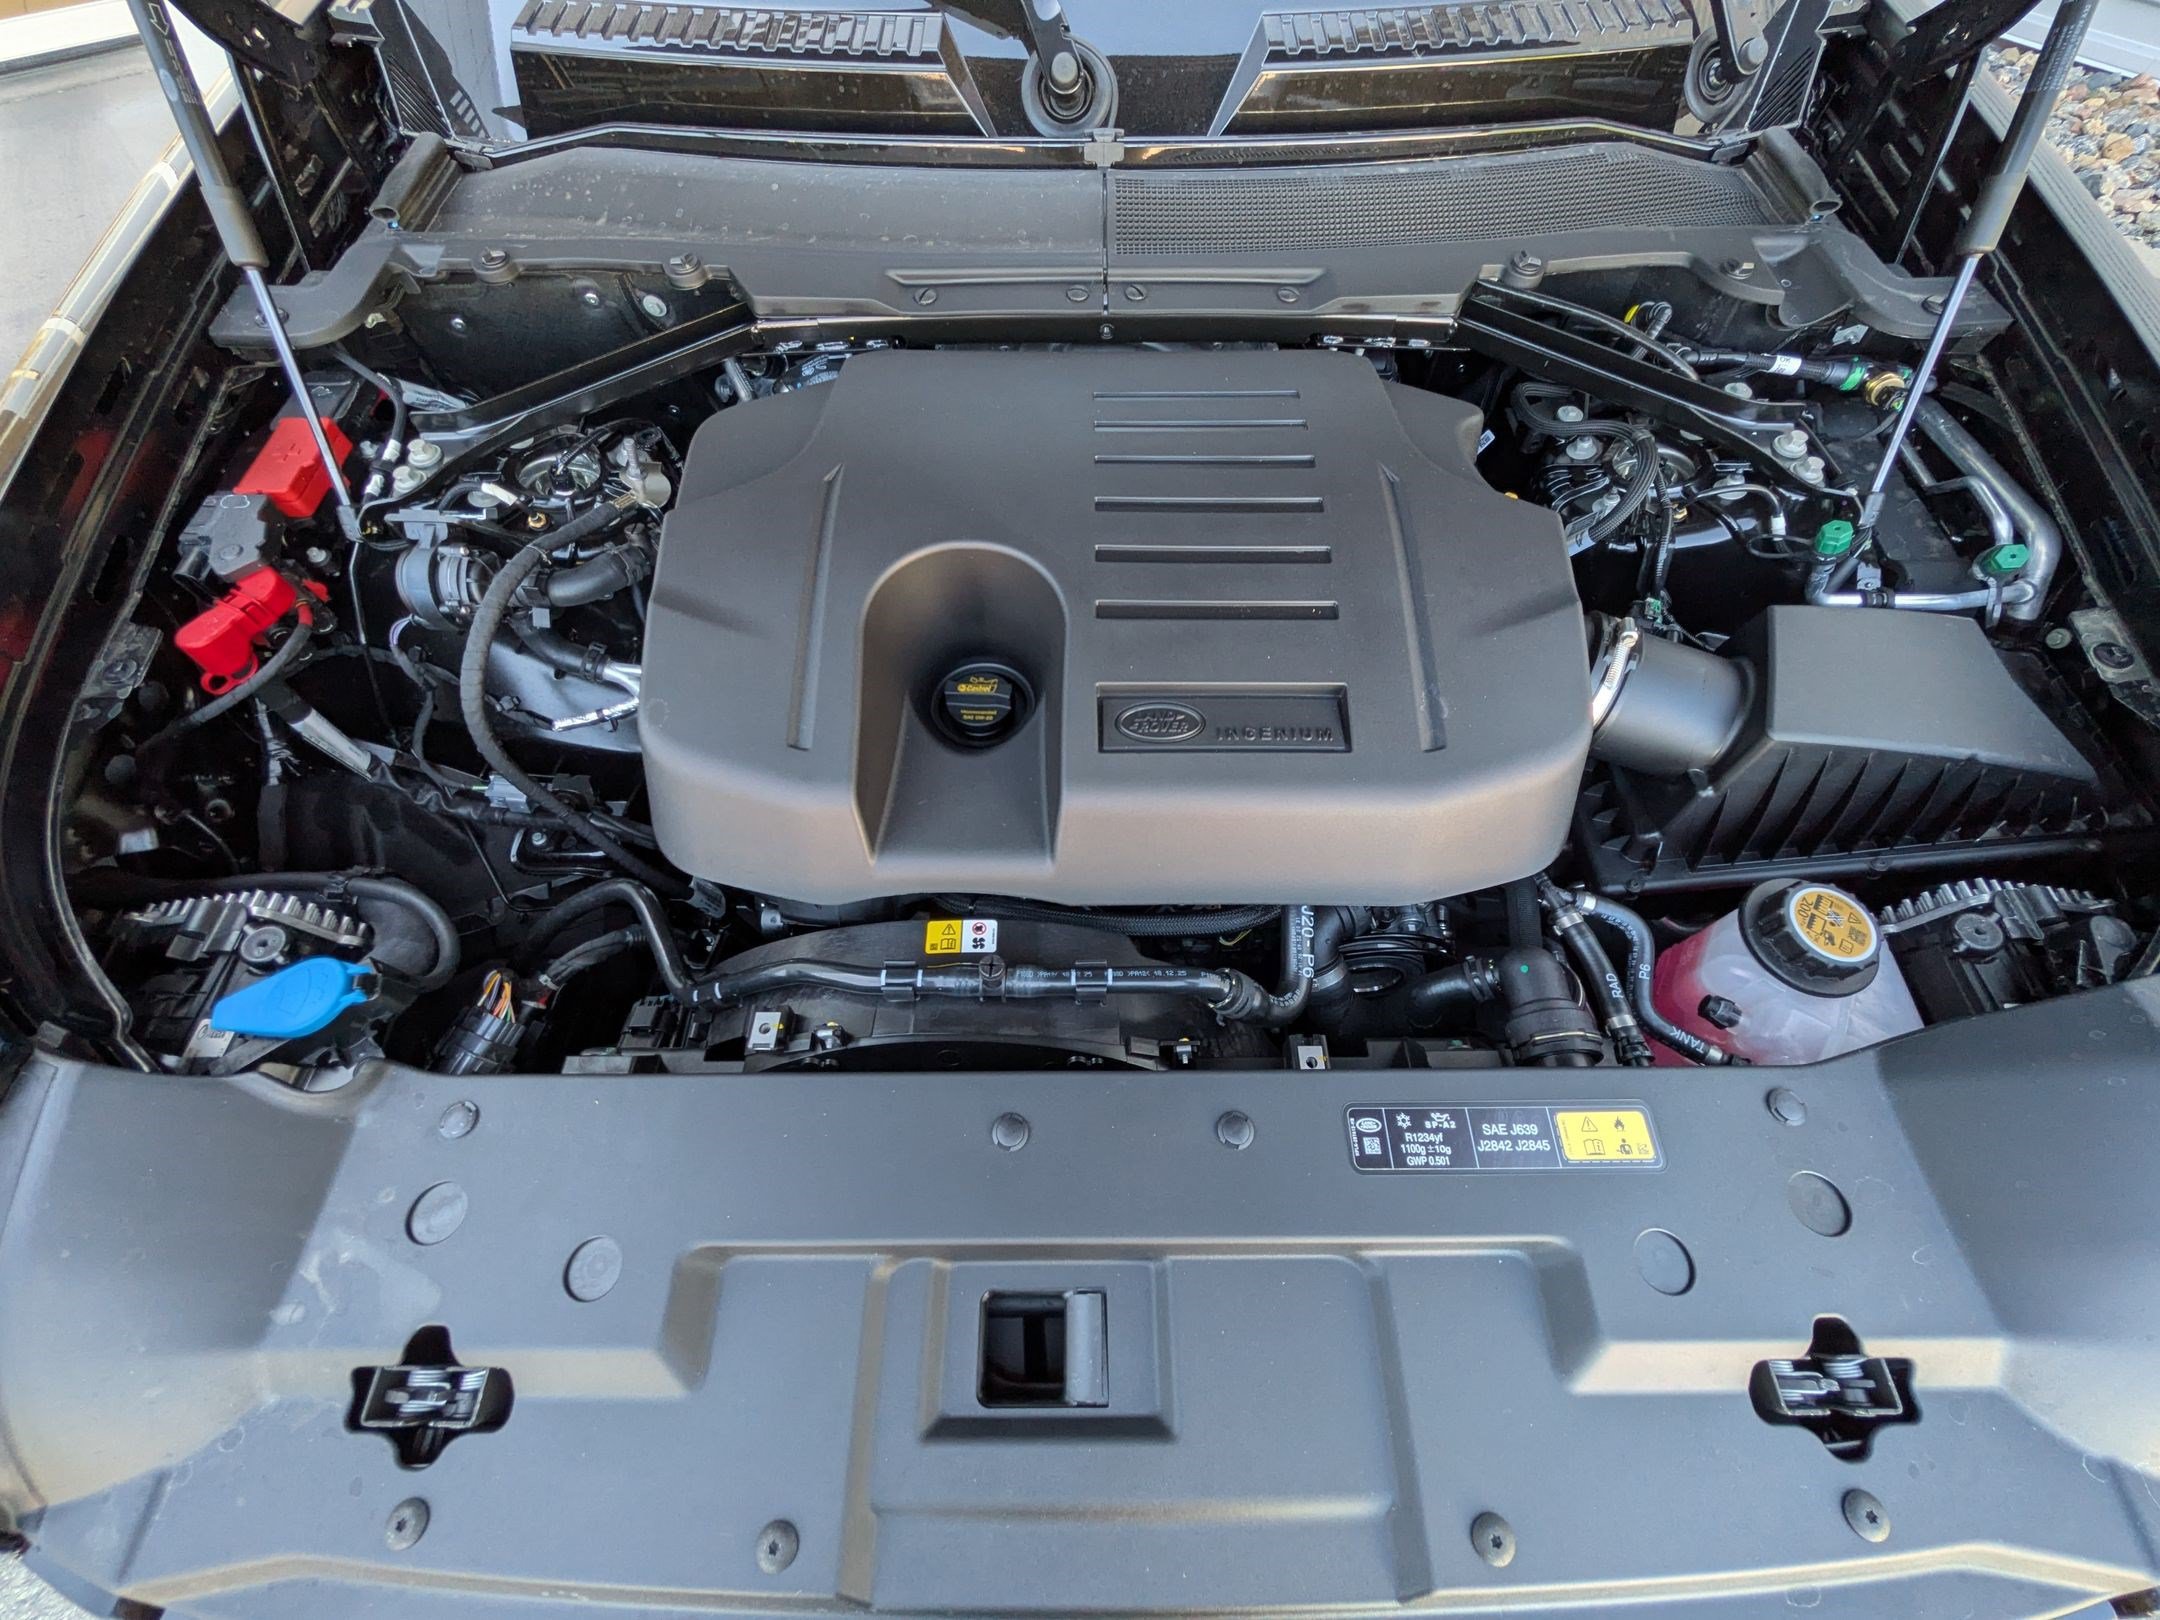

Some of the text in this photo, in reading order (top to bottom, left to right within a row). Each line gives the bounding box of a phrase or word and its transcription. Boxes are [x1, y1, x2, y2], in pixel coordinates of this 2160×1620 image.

[1137, 722, 1189, 733] ROVER
[1216, 727, 1334, 741] INGENIUM
[1638, 963, 1651, 981] P6
[1606, 972, 1624, 999] RAD
[1670, 1025, 1705, 1054] TANK
[1424, 1121, 1456, 1129] SP-A2
[1482, 1123, 1538, 1136] SAE J639
[1405, 1132, 1444, 1144] R1234yf
[1400, 1143, 1426, 1155] 1100g
[1477, 1139, 1551, 1152] J2842 J2845
[1406, 1155, 1451, 1166] GWP 0.501
